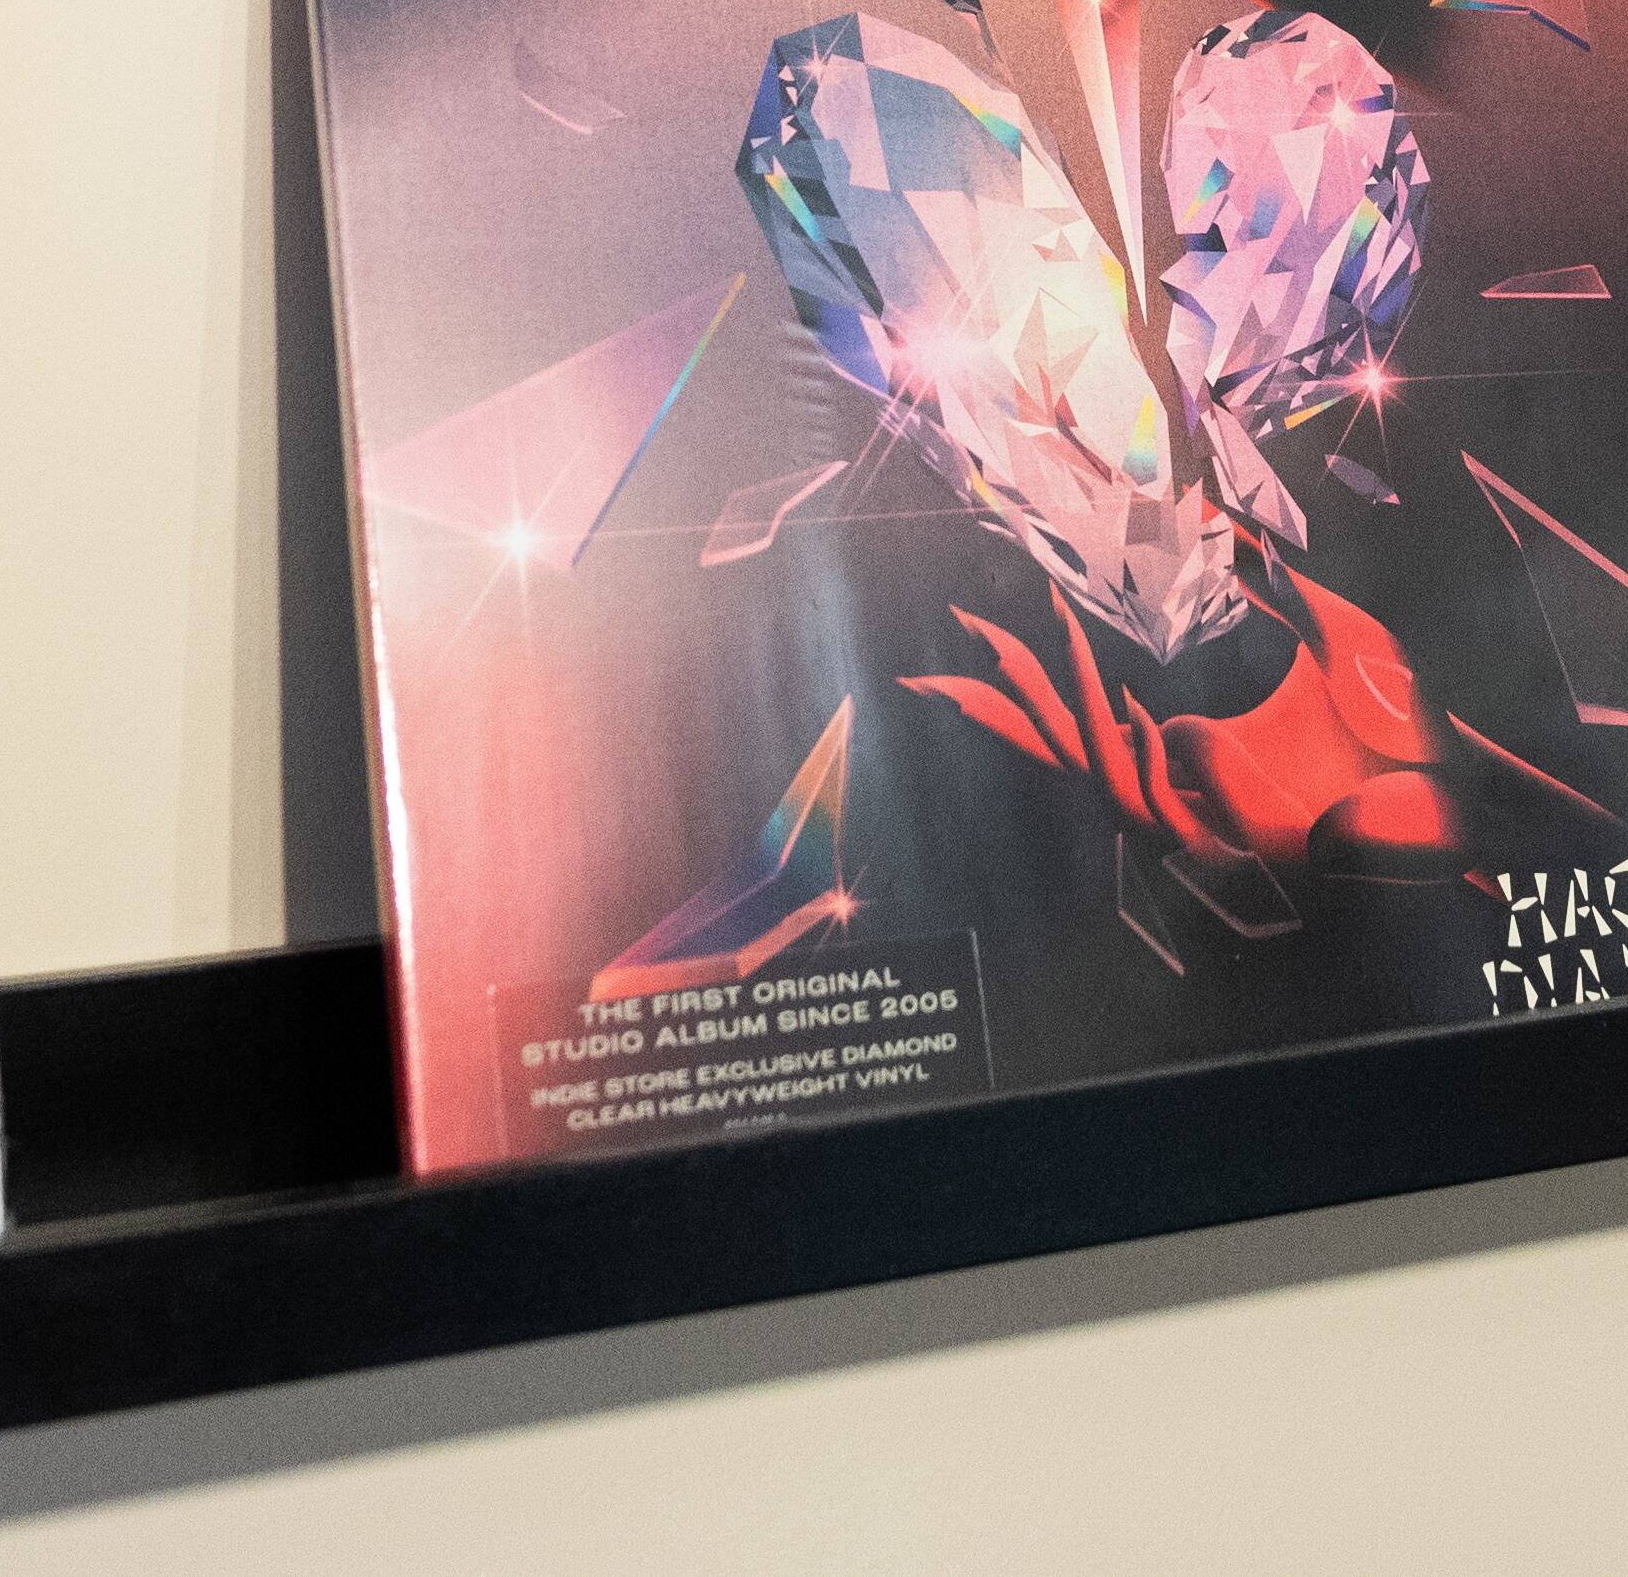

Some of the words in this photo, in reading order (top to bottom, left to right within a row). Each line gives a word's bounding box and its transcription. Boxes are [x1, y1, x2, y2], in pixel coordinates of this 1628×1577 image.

[521, 1030, 644, 1067] STUDIO
[654, 1013, 768, 1049] ALBUM
[776, 1000, 871, 1032] SINCE
[880, 989, 959, 1020] 2005
[578, 998, 643, 1026] THE
[652, 985, 742, 1018] FIRST
[752, 967, 901, 1005] ORIGINAL
[530, 1080, 599, 1108] INDIE
[604, 1068, 690, 1098] STORE
[695, 1048, 836, 1086] EXCLUSIVE
[841, 1033, 958, 1065] DIAMOND
[566, 1099, 657, 1131] CLEAR
[658, 1073, 850, 1116] HEAVYWEIGHT
[855, 1063, 930, 1089] VINYL
